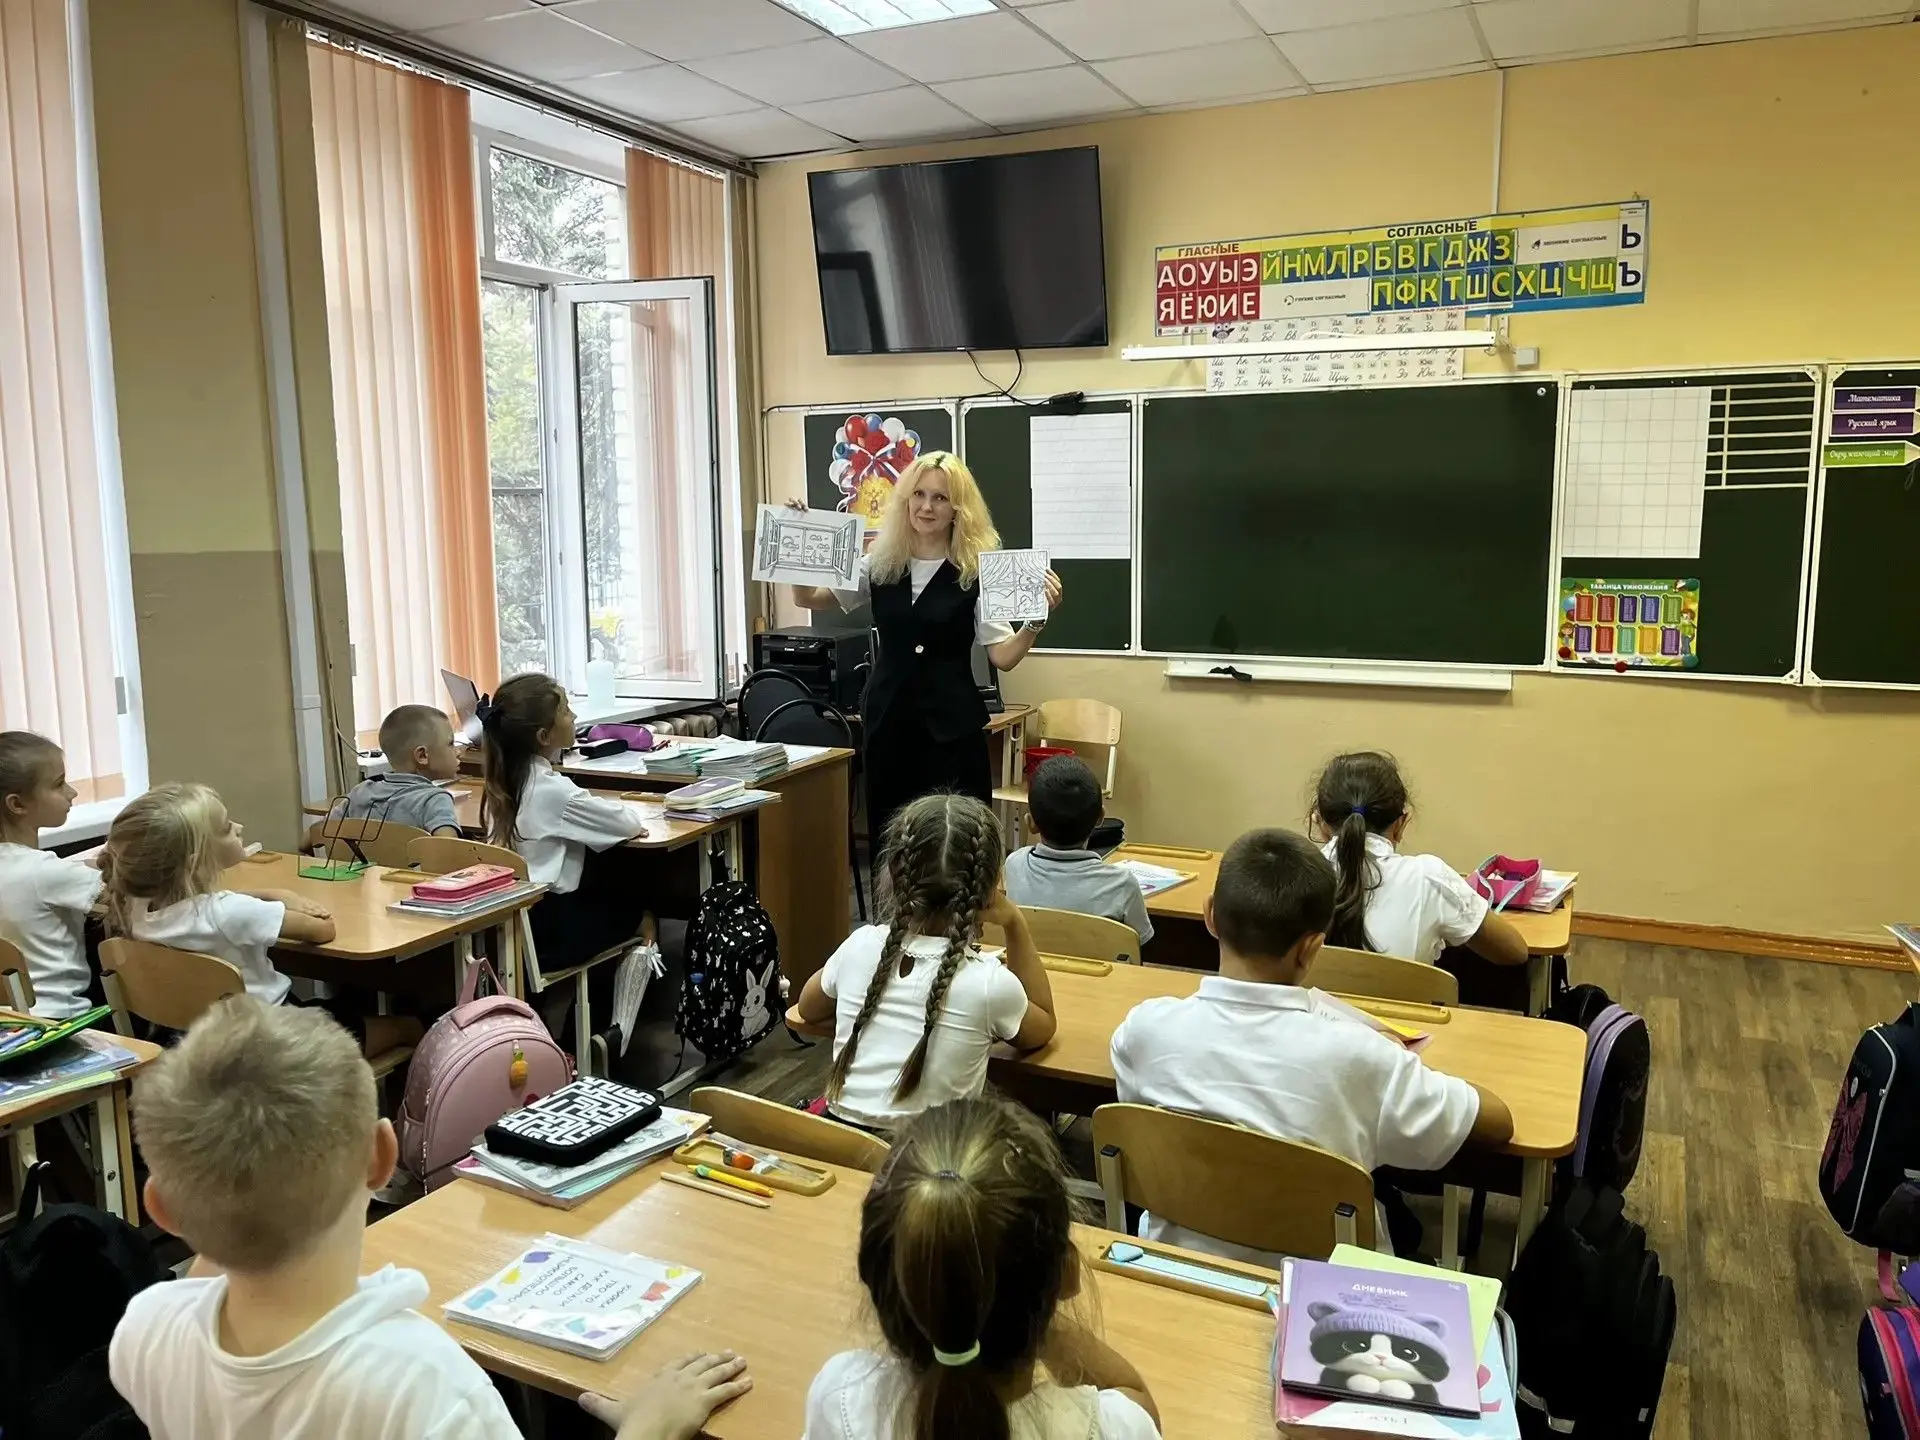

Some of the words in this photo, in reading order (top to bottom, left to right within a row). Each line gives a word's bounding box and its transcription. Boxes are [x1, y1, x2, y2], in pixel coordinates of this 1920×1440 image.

[1387, 220, 1478, 239] СОГЛАСНЫЕ
[1621, 223, 1642, 249] Ь
[1178, 243, 1240, 258] ГЛАСНЫЕ
[1847, 419, 1878, 430] Русский
[1351, 1283, 1408, 1298] ДНЕВНИК
